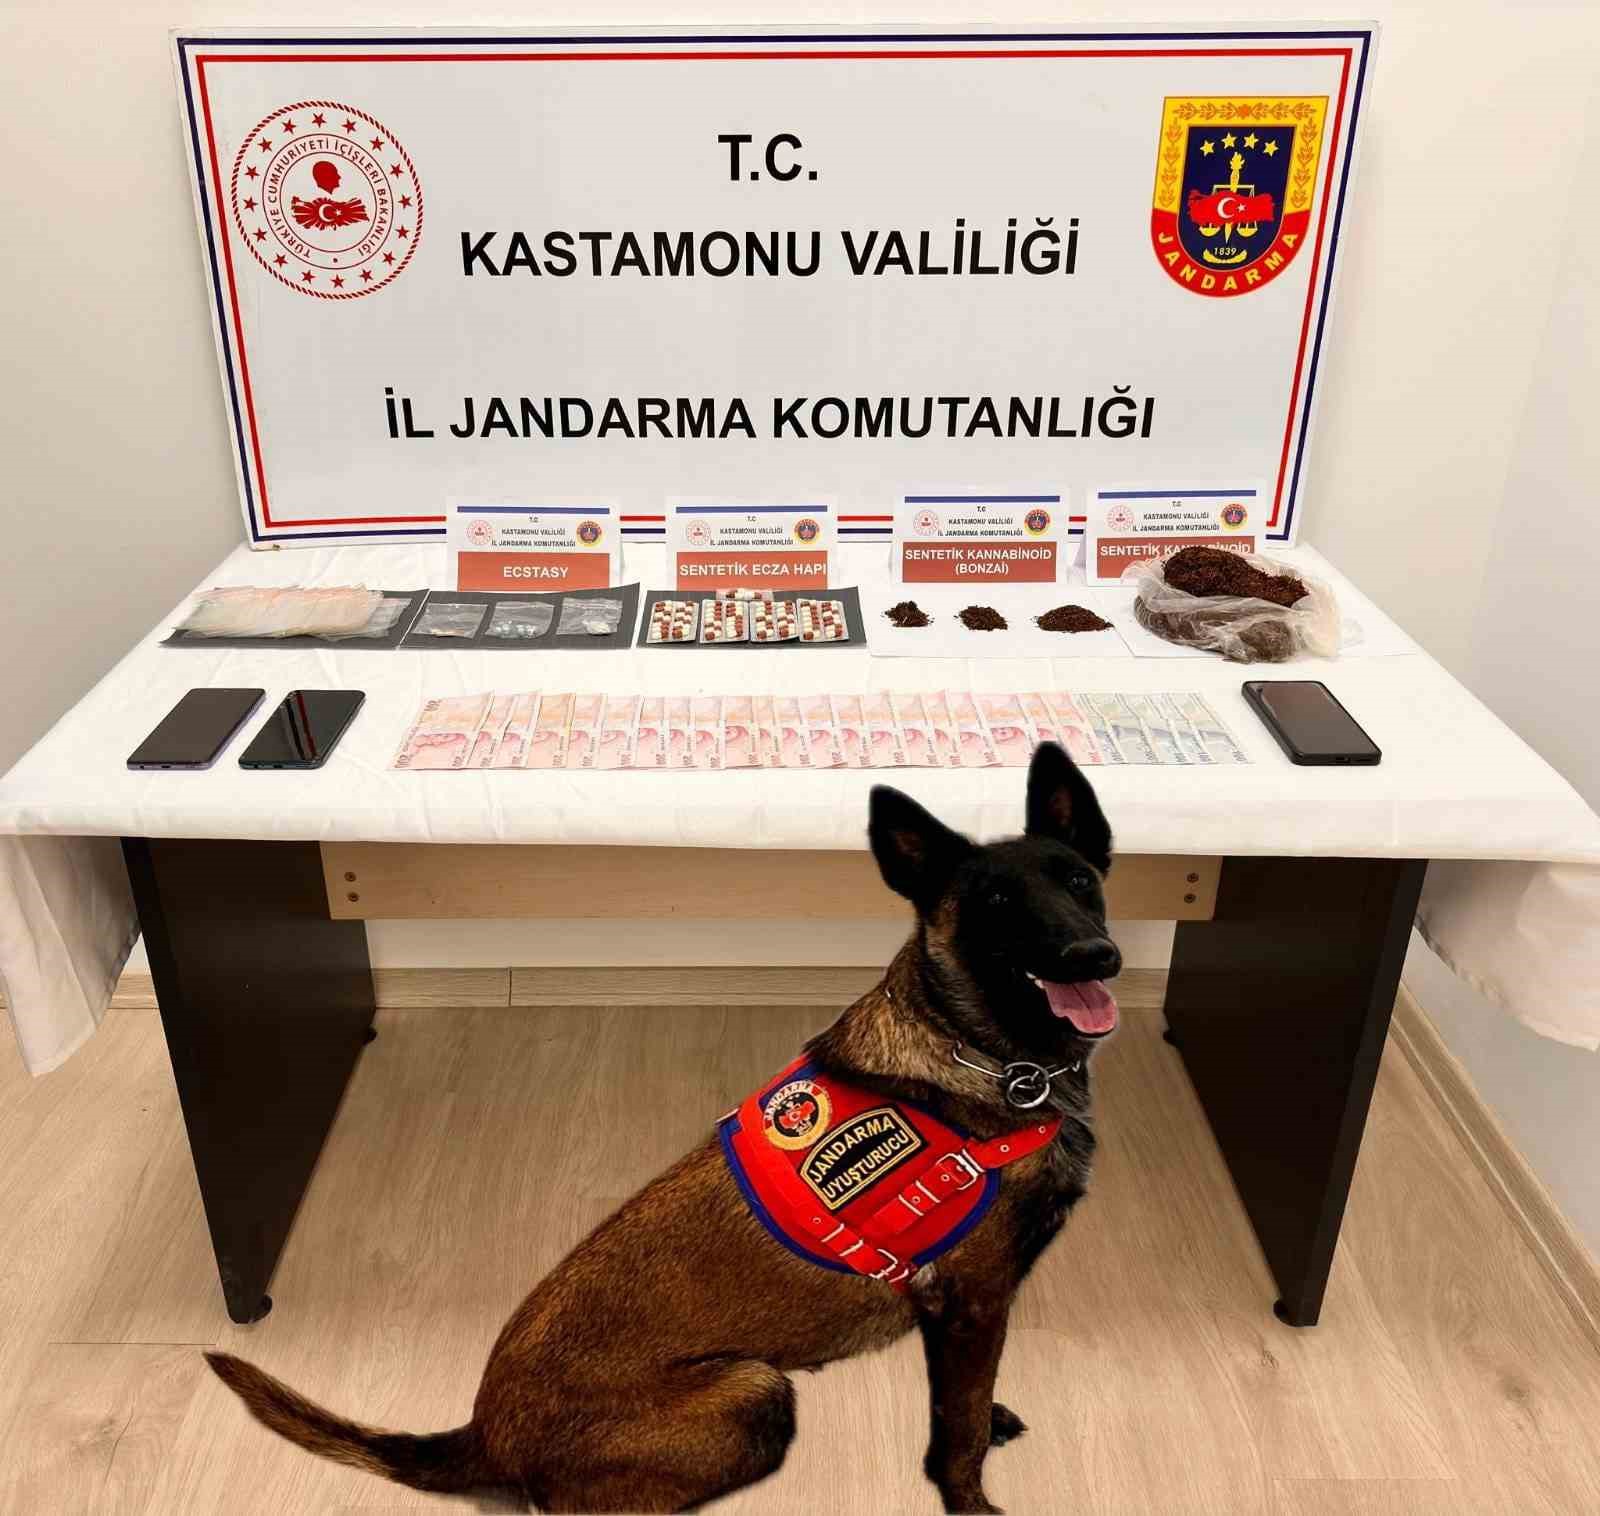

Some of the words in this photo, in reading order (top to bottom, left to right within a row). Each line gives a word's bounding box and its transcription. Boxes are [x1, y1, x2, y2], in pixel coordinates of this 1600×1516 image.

[267, 137, 330, 204] CUMHURİYETİ
[334, 137, 384, 184] İÇİŞLERİ
[718, 134, 817, 181] T.C.
[269, 209, 311, 259] TÜRKİYE
[358, 188, 387, 257] BAKANLIĞI
[461, 231, 820, 276] KASTAMONU
[841, 218, 1079, 275] VALİLİĞİ
[1157, 231, 1299, 291] JANDARMA
[1213, 246, 1238, 257] 1839
[385, 387, 434, 438] İL
[450, 398, 756, 438] JANDARMA
[774, 386, 1154, 438] KOMUTANLIĞI
[503, 566, 569, 578] ECSTASY
[680, 561, 748, 576] SENTETİK
[752, 563, 790, 575] ECZA
[793, 563, 827, 575] HAPI
[905, 546, 964, 560] SENTETİK
[966, 546, 1052, 560] KANNABİNOİD
[955, 561, 1009, 575] (BONZAİ)
[1100, 543, 1161, 557] SENTETİK
[811, 1114, 896, 1183] JANDARMA
[822, 1130, 910, 1201] UYUŞTURUCU
